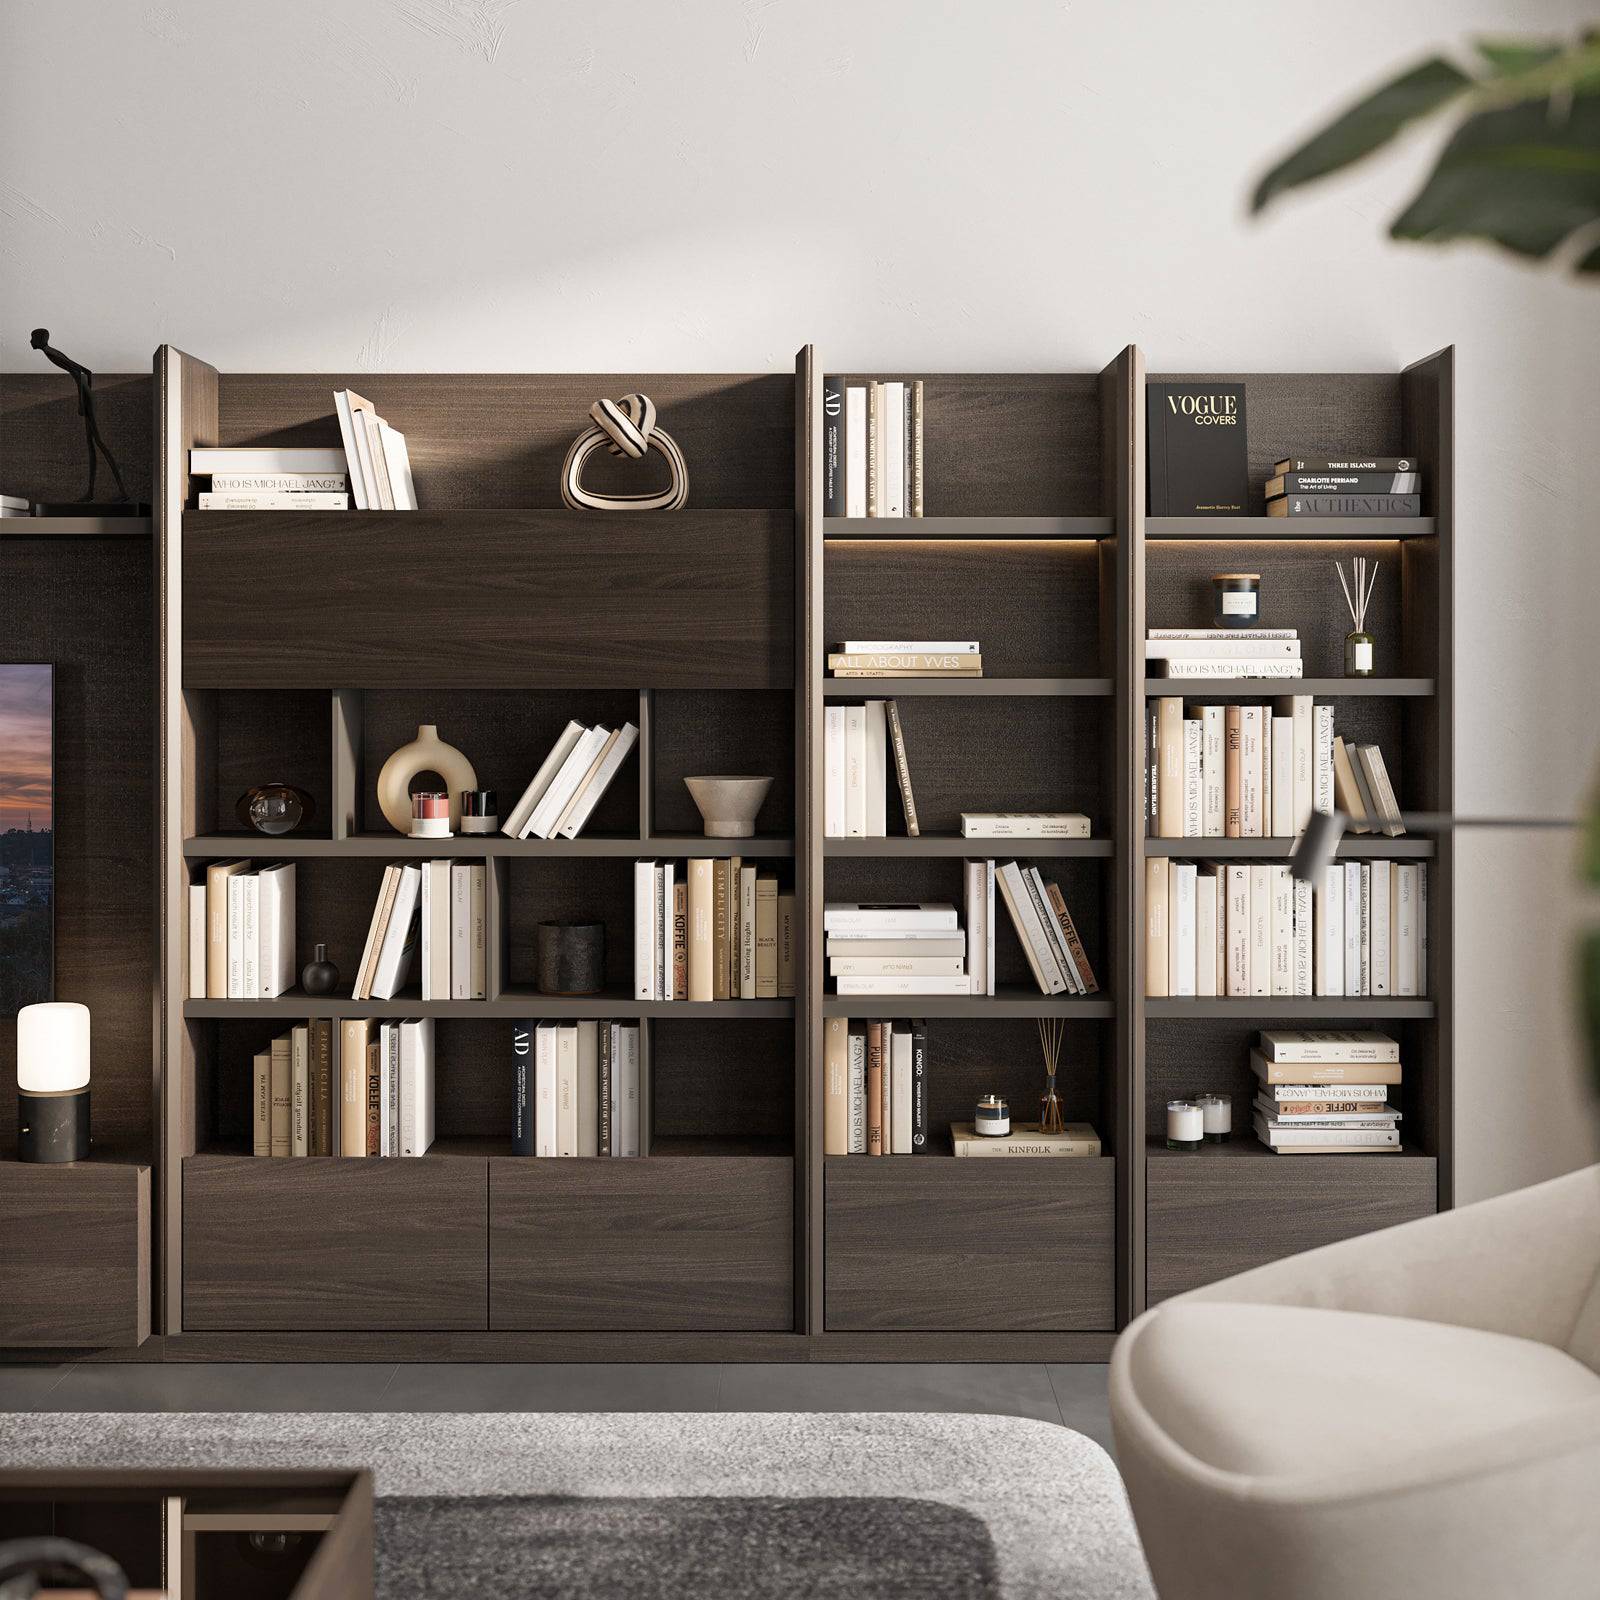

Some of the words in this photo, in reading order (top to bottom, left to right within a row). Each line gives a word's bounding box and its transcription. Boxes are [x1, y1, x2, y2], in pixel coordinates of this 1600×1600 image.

[826, 389, 840, 416] AD
[1168, 395, 1237, 415] VOGUE
[1195, 415, 1237, 425] COVERS
[213, 480, 241, 488] WHO
[242, 480, 252, 488] IS
[252, 480, 302, 488] MICHAEL
[302, 480, 336, 488] JANG?
[1302, 499, 1412, 513] AUTHENTICS
[836, 656, 862, 668] ALL
[866, 656, 917, 668] ABOUT
[924, 656, 959, 668] YVES
[1169, 664, 1198, 674] WHO
[1200, 664, 1210, 674] IS
[1210, 664, 1258, 674] MICHAEL
[1259, 664, 1293, 674] JANG?
[1230, 728, 1239, 750] PUUR
[1320, 715, 1328, 748] JANG?
[1190, 727, 1198, 757] JANG?
[1190, 759, 1198, 802] MICHAEL
[1320, 750, 1328, 797] MICHAEL
[1190, 802, 1198, 812] IS
[1320, 798, 1328, 809] IS
[1230, 808, 1239, 824] THEE
[1190, 813, 1198, 836] WHO
[232, 879, 239, 888] No
[675, 914, 685, 949] KOFFIE
[1058, 911, 1079, 947] KOFFIE
[515, 1028, 529, 1055] AD
[854, 1045, 862, 1074] JANG?
[871, 1046, 880, 1068] PUUR
[854, 1075, 862, 1116] MICHAEL
[1282, 1089, 1310, 1097] JANG?
[1312, 1089, 1352, 1097] MICHAEL
[1354, 1089, 1363, 1097] IS
[1365, 1089, 1386, 1097] WHO
[1326, 1103, 1357, 1112] KOFFIE
[854, 1118, 862, 1126] IS
[854, 1128, 862, 1152] WHO
[871, 1127, 880, 1143] THEE
[1008, 1146, 1050, 1154] KINFOLK
